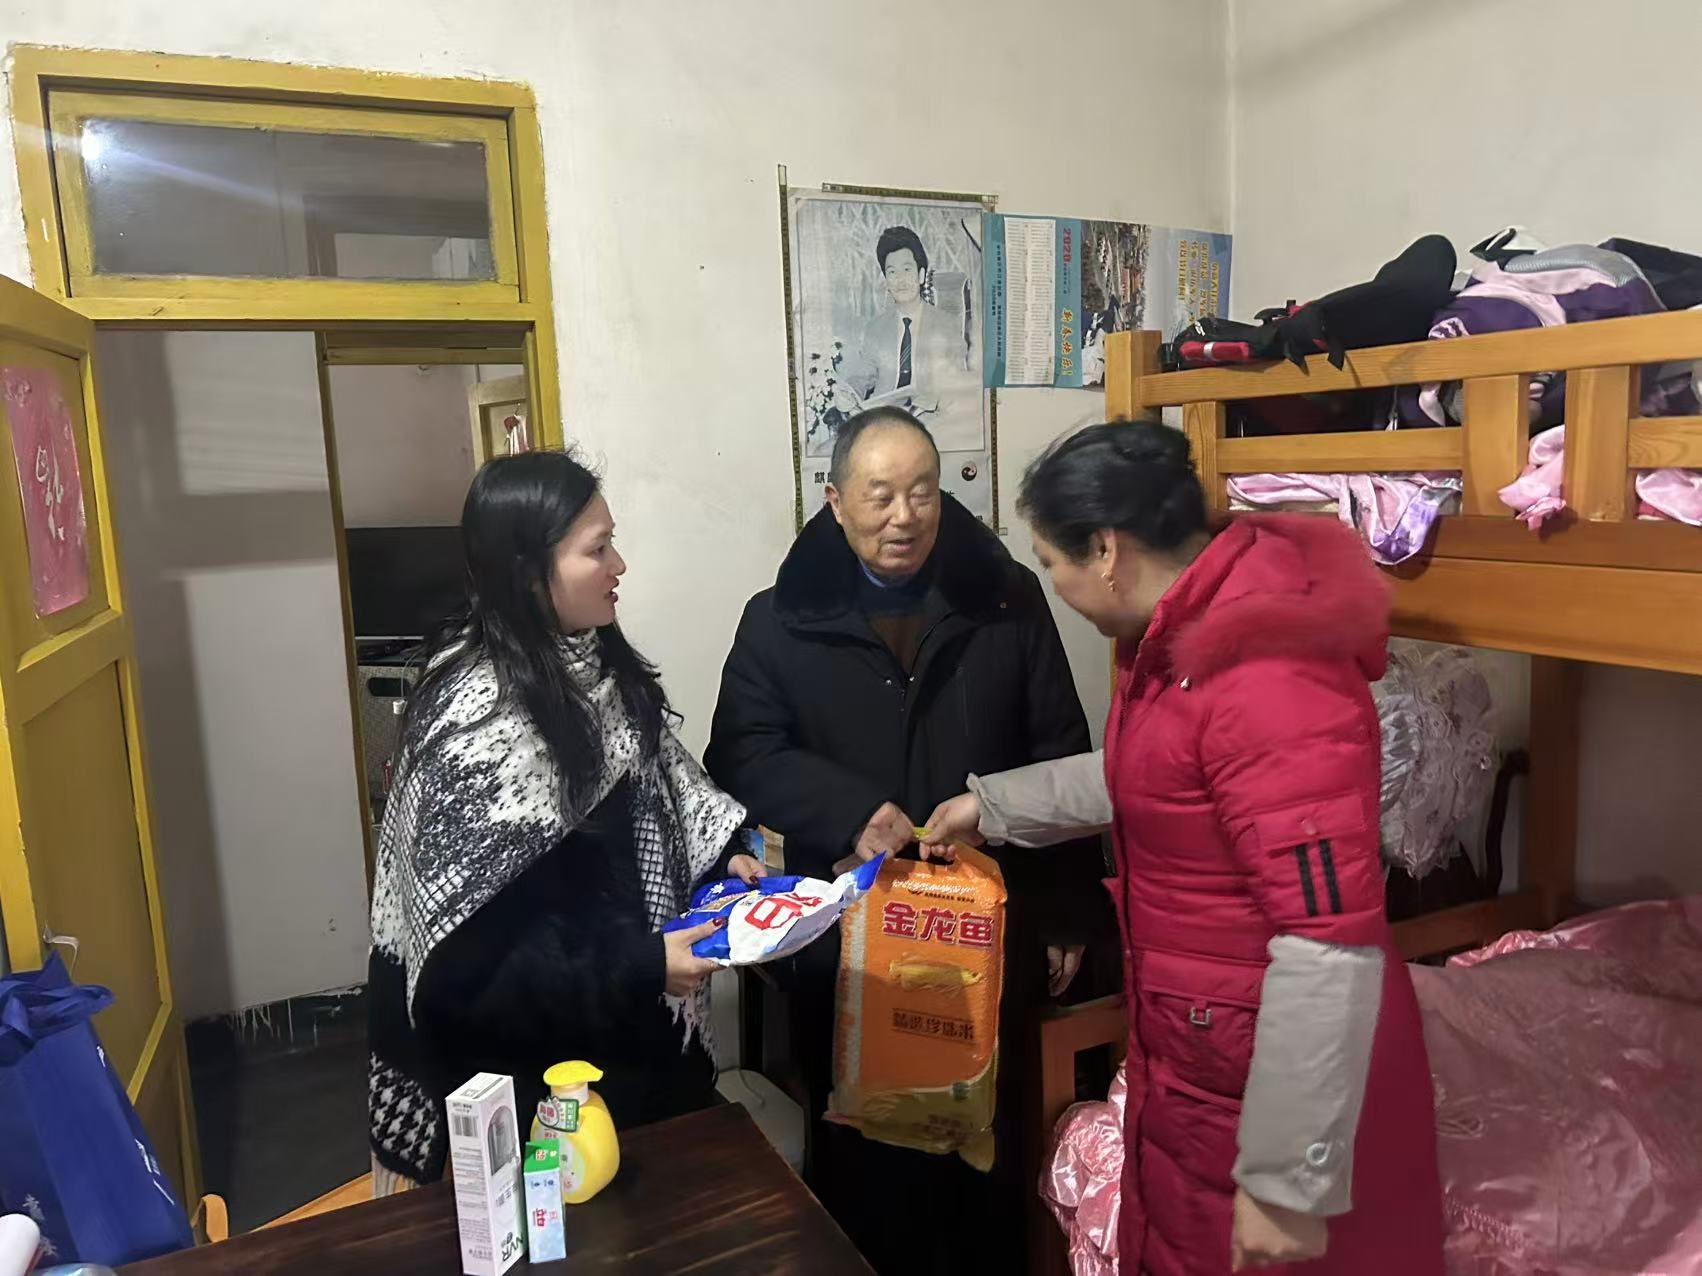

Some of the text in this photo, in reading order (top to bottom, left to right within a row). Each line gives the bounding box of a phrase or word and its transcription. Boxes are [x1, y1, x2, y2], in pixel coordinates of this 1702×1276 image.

[1063, 228, 1072, 263] 2020
[883, 901, 994, 947] 金龙鱼
